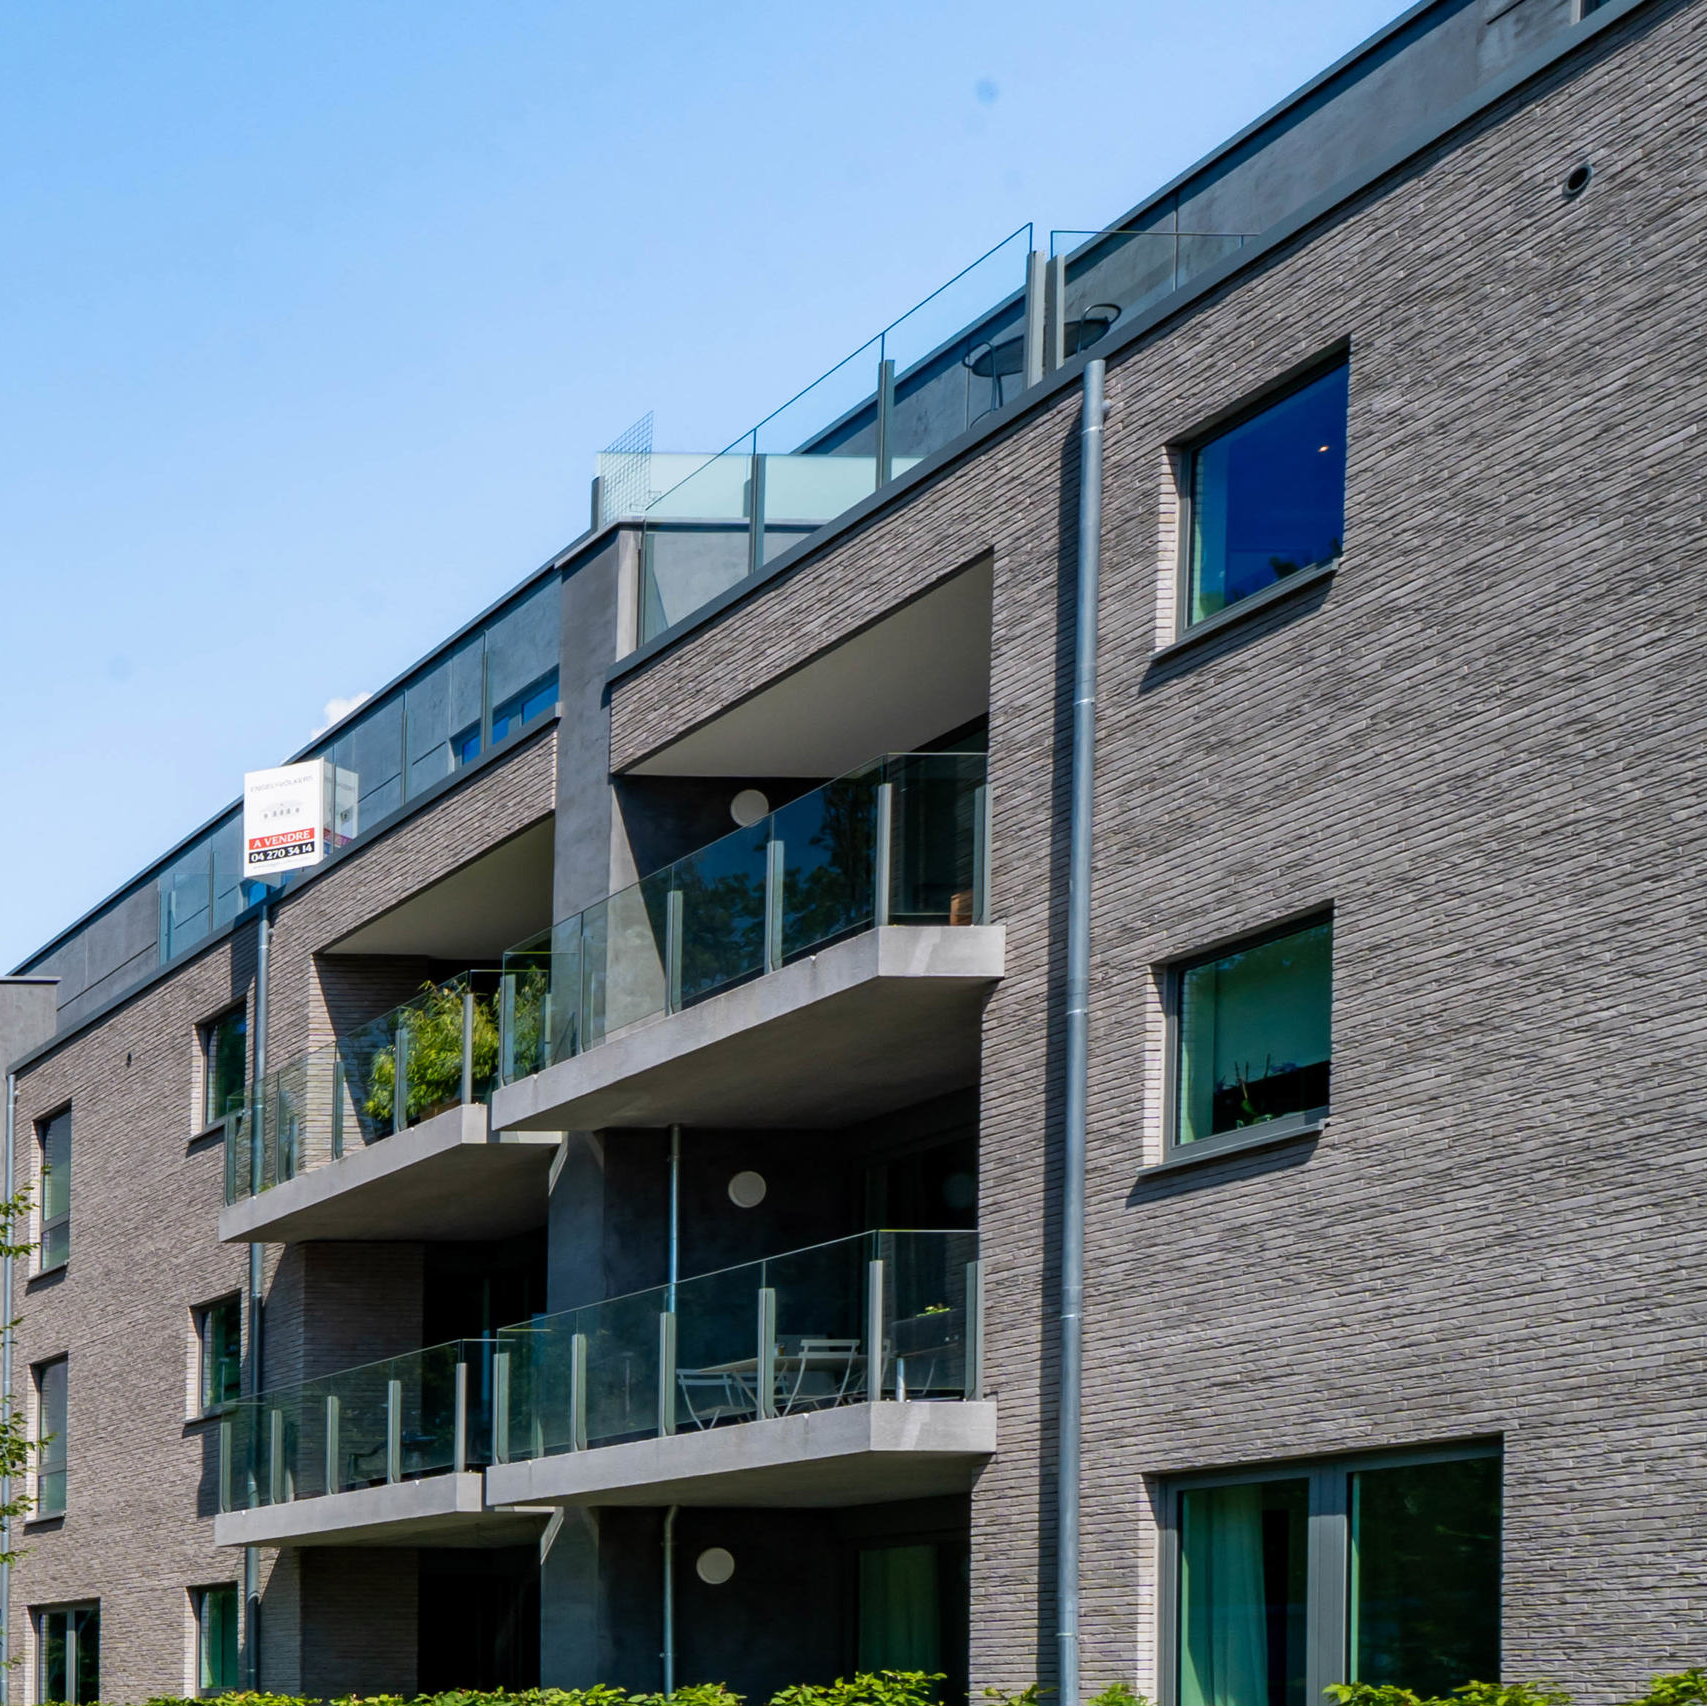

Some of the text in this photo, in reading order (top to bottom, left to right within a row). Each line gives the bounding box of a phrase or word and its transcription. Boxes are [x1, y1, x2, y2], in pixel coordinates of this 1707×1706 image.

[253, 830, 311, 848] A VENDRE
[251, 843, 313, 862] 04 270 34 14
